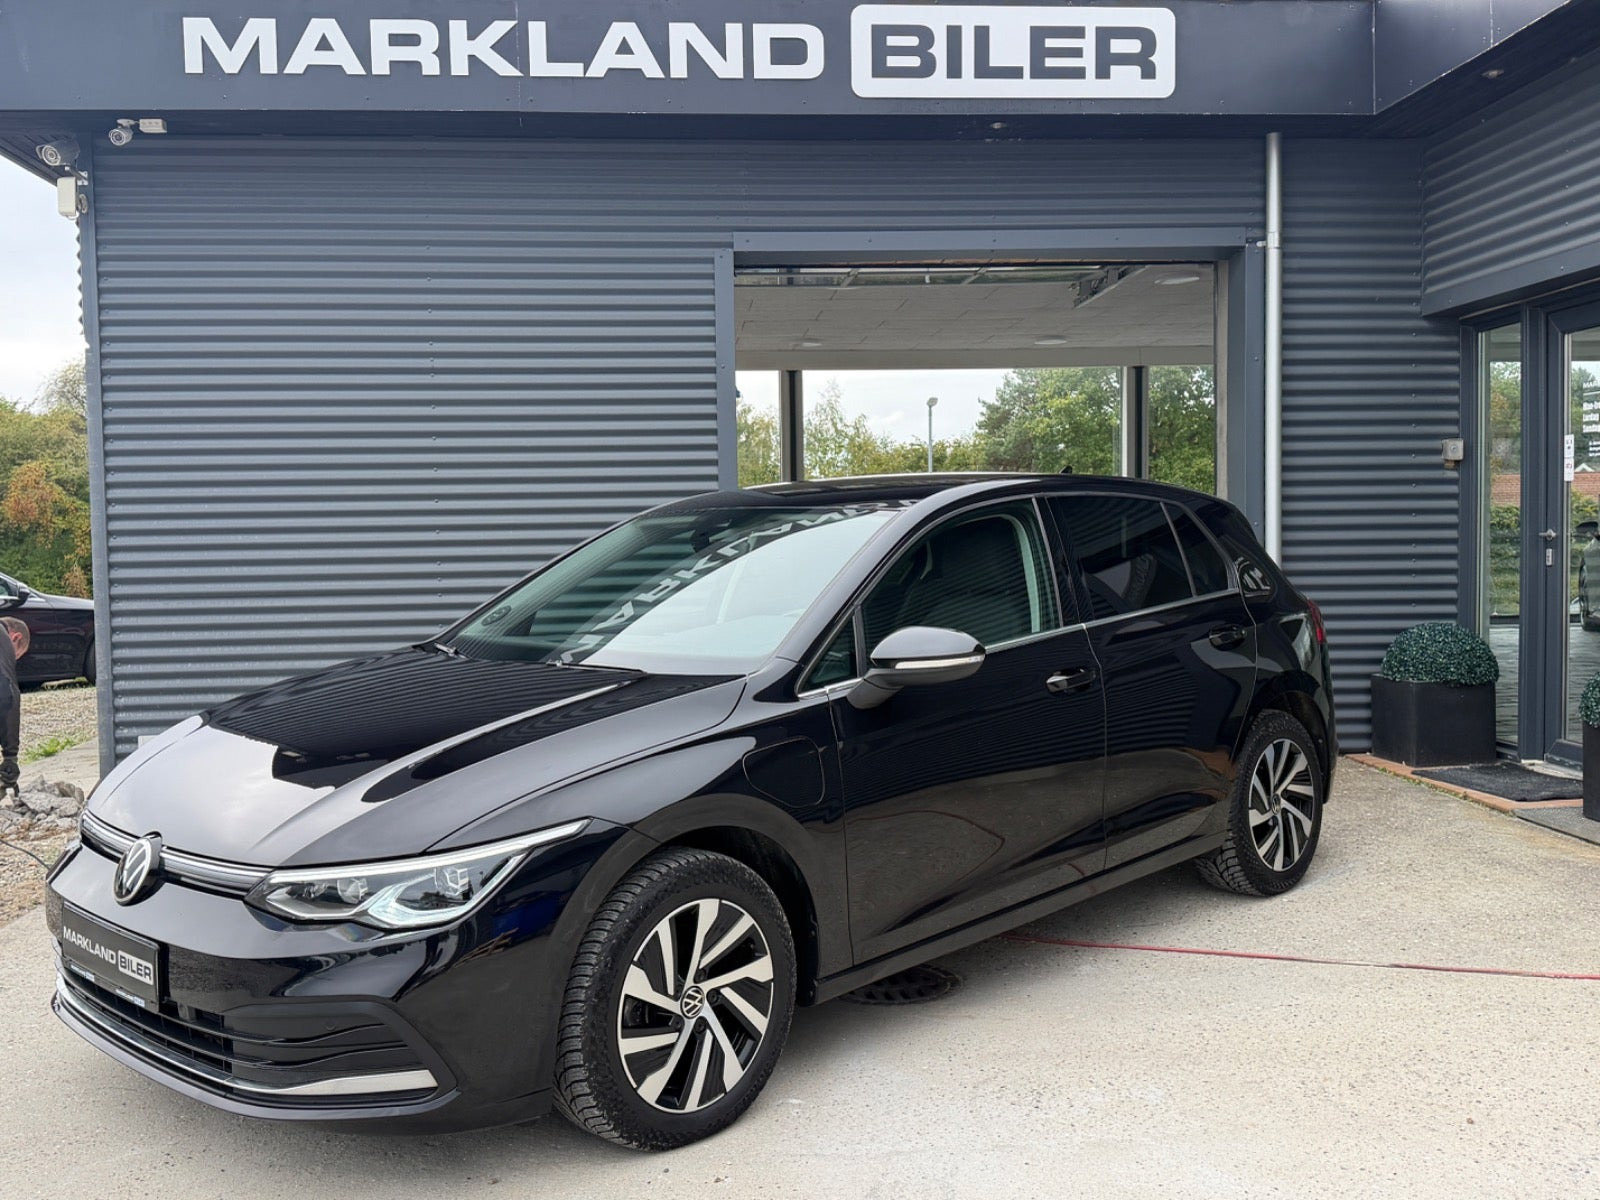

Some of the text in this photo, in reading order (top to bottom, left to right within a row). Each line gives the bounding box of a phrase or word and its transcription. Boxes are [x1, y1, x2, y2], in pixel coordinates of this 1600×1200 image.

[182, 16, 1157, 81] MARKLAND BILER
[63, 926, 116, 965] MARKLAND
[119, 953, 152, 981] BILER
